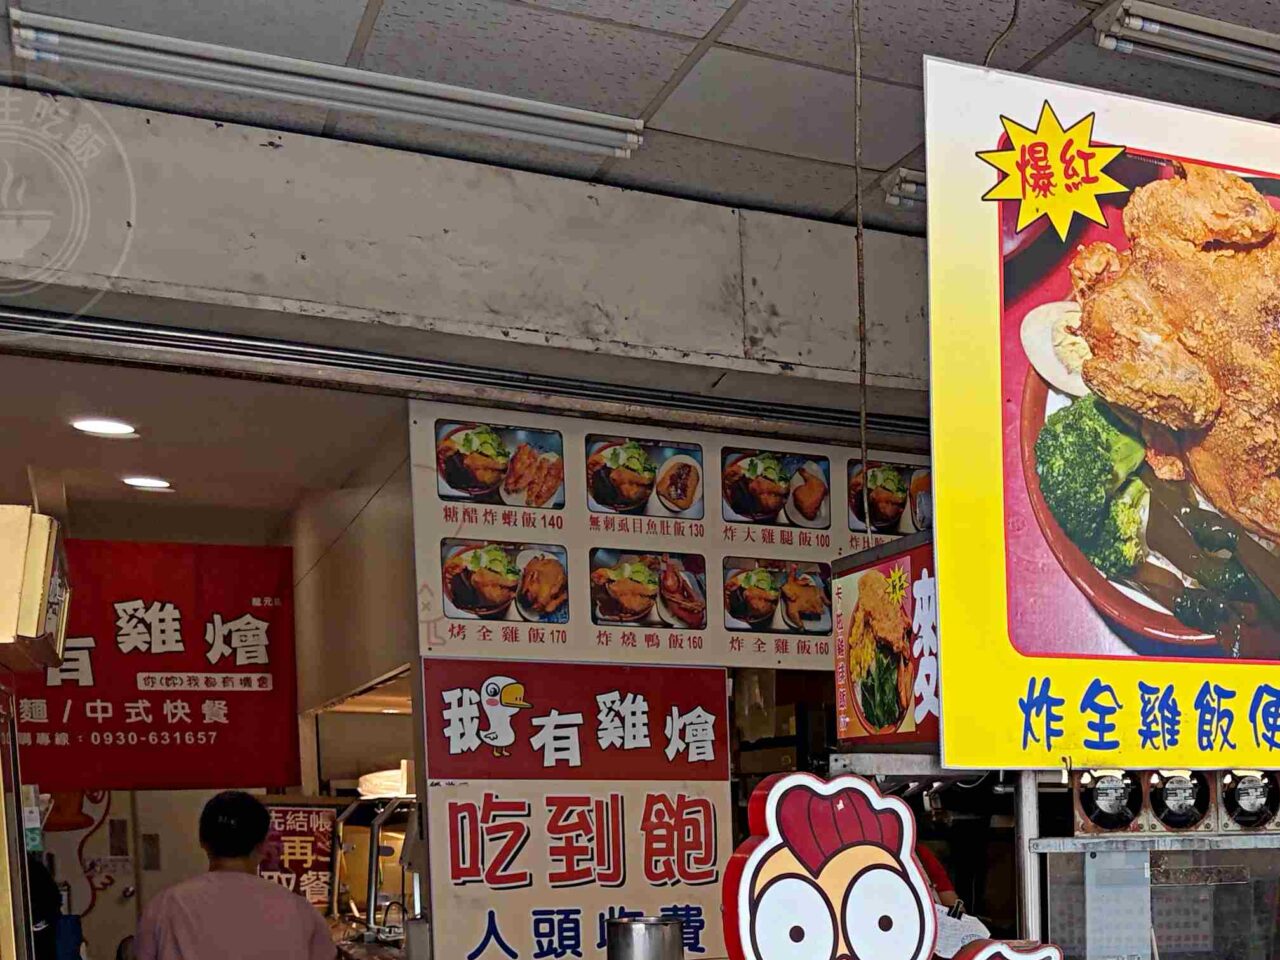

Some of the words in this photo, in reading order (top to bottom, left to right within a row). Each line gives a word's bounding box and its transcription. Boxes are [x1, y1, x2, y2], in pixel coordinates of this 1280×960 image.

[1015, 139, 1099, 198] 爆紅
[280, 836, 316, 868] 再
[447, 792, 718, 888] 吃到飽
